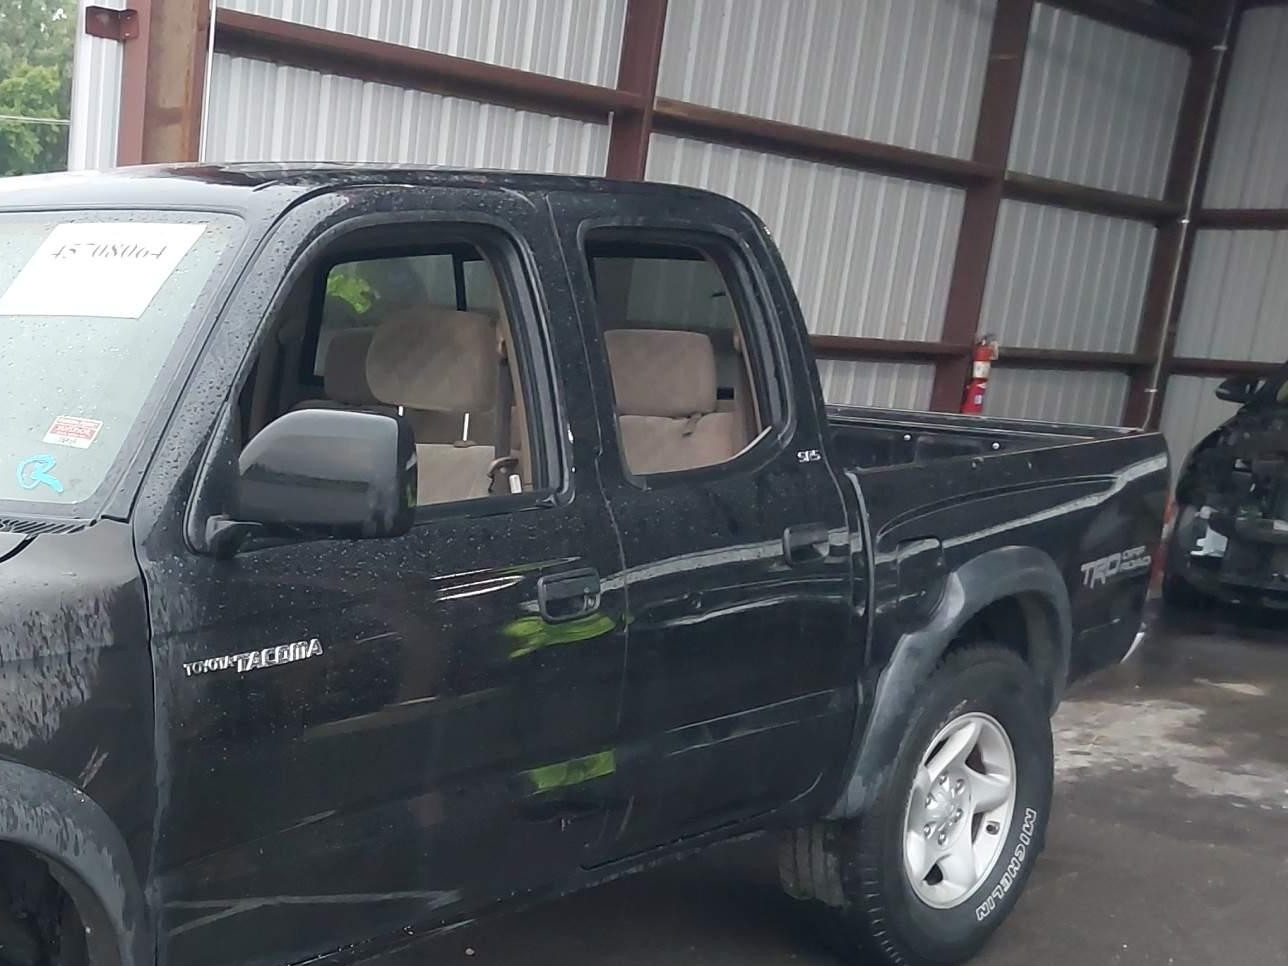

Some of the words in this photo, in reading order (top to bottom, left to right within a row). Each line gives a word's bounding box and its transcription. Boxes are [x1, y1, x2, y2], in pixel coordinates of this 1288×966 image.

[1080, 553, 1121, 589] TRD
[183, 655, 236, 677] TOYOTA
[235, 638, 324, 673] TACOMA
[975, 807, 1037, 921] MICHELIN
